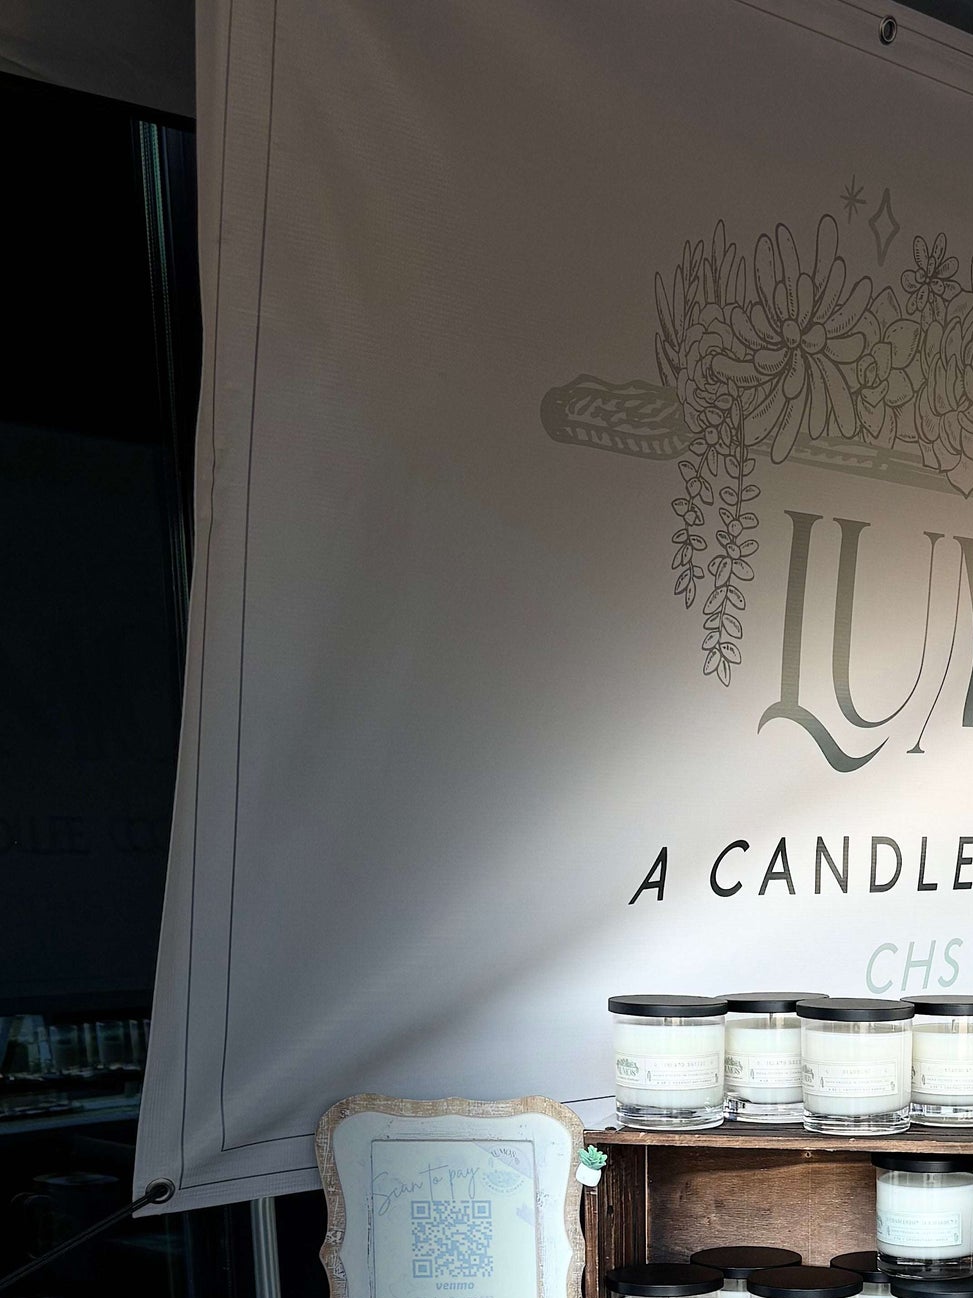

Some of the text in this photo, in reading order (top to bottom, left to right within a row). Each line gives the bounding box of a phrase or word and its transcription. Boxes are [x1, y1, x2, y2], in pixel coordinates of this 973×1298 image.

[627, 845, 670, 905] A
[865, 936, 961, 995] CHS
[372, 1171, 423, 1216] Scan
[448, 1167, 480, 1199] pay
[436, 1281, 475, 1290] venmo
